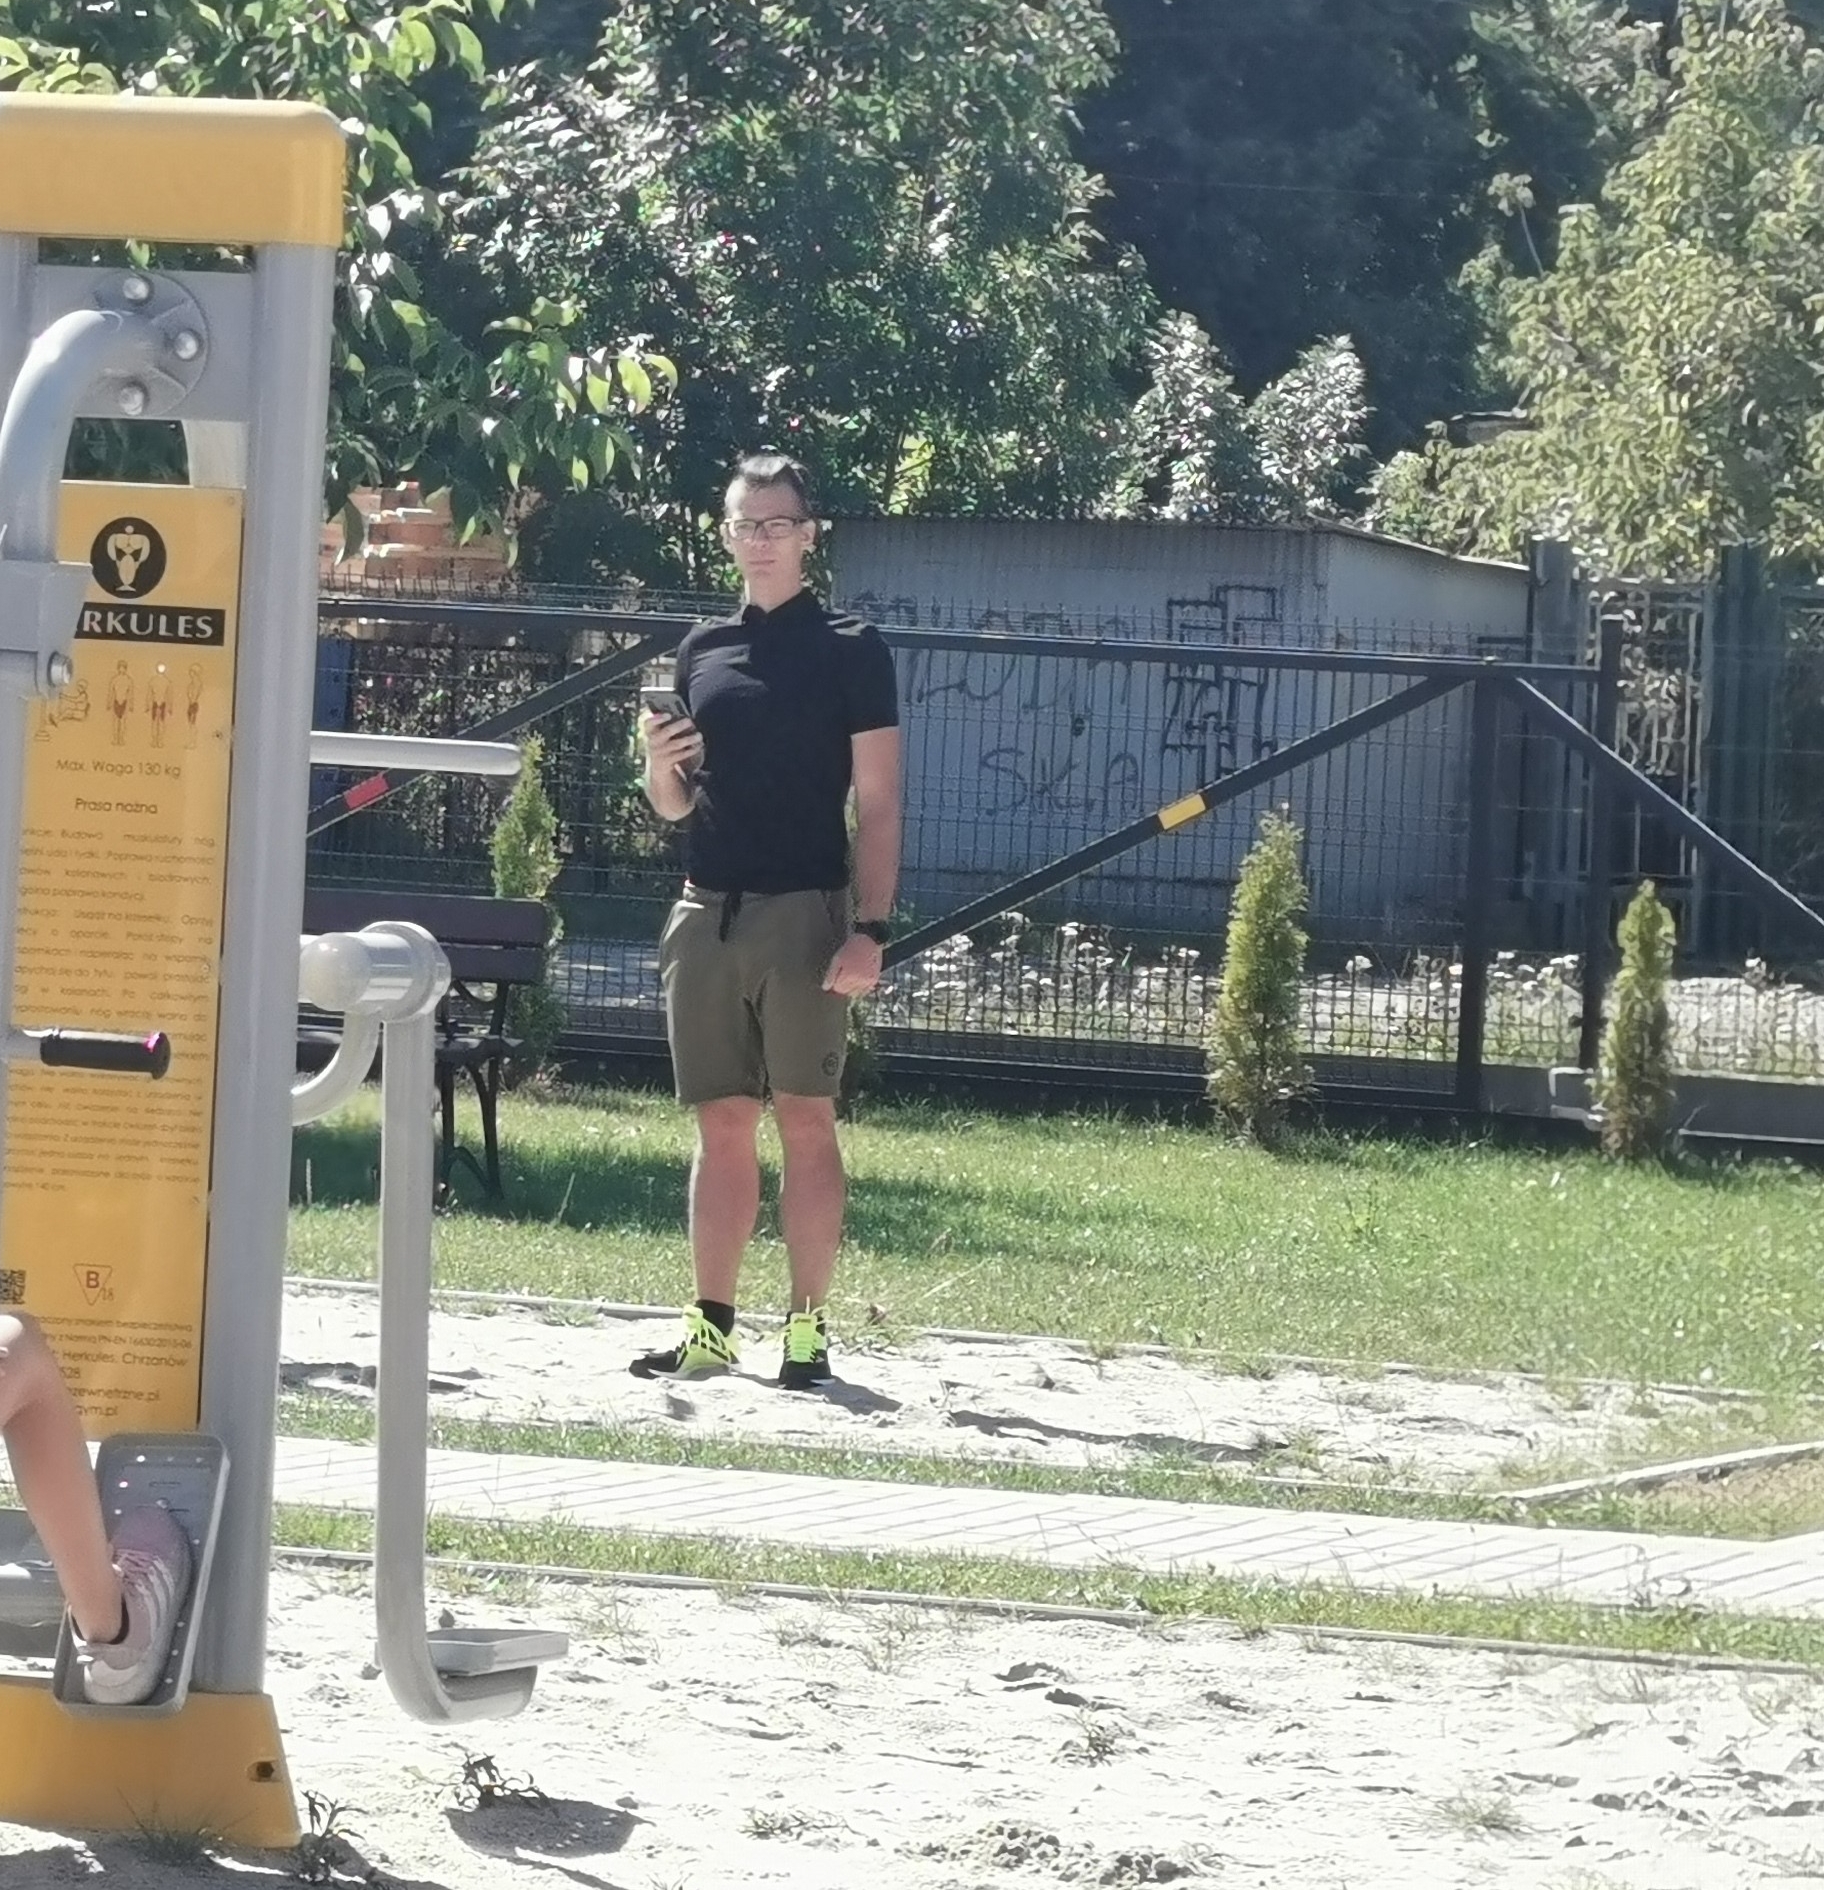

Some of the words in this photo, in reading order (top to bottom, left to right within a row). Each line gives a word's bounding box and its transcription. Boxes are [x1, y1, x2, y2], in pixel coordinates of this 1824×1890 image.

[82, 610, 213, 639] RKULES
[92, 760, 133, 777] Waga
[139, 762, 161, 775] 130
[165, 763, 181, 779] kg
[75, 797, 112, 812] Prasa
[86, 1271, 100, 1289] B
[60, 1366, 81, 1379] 528
